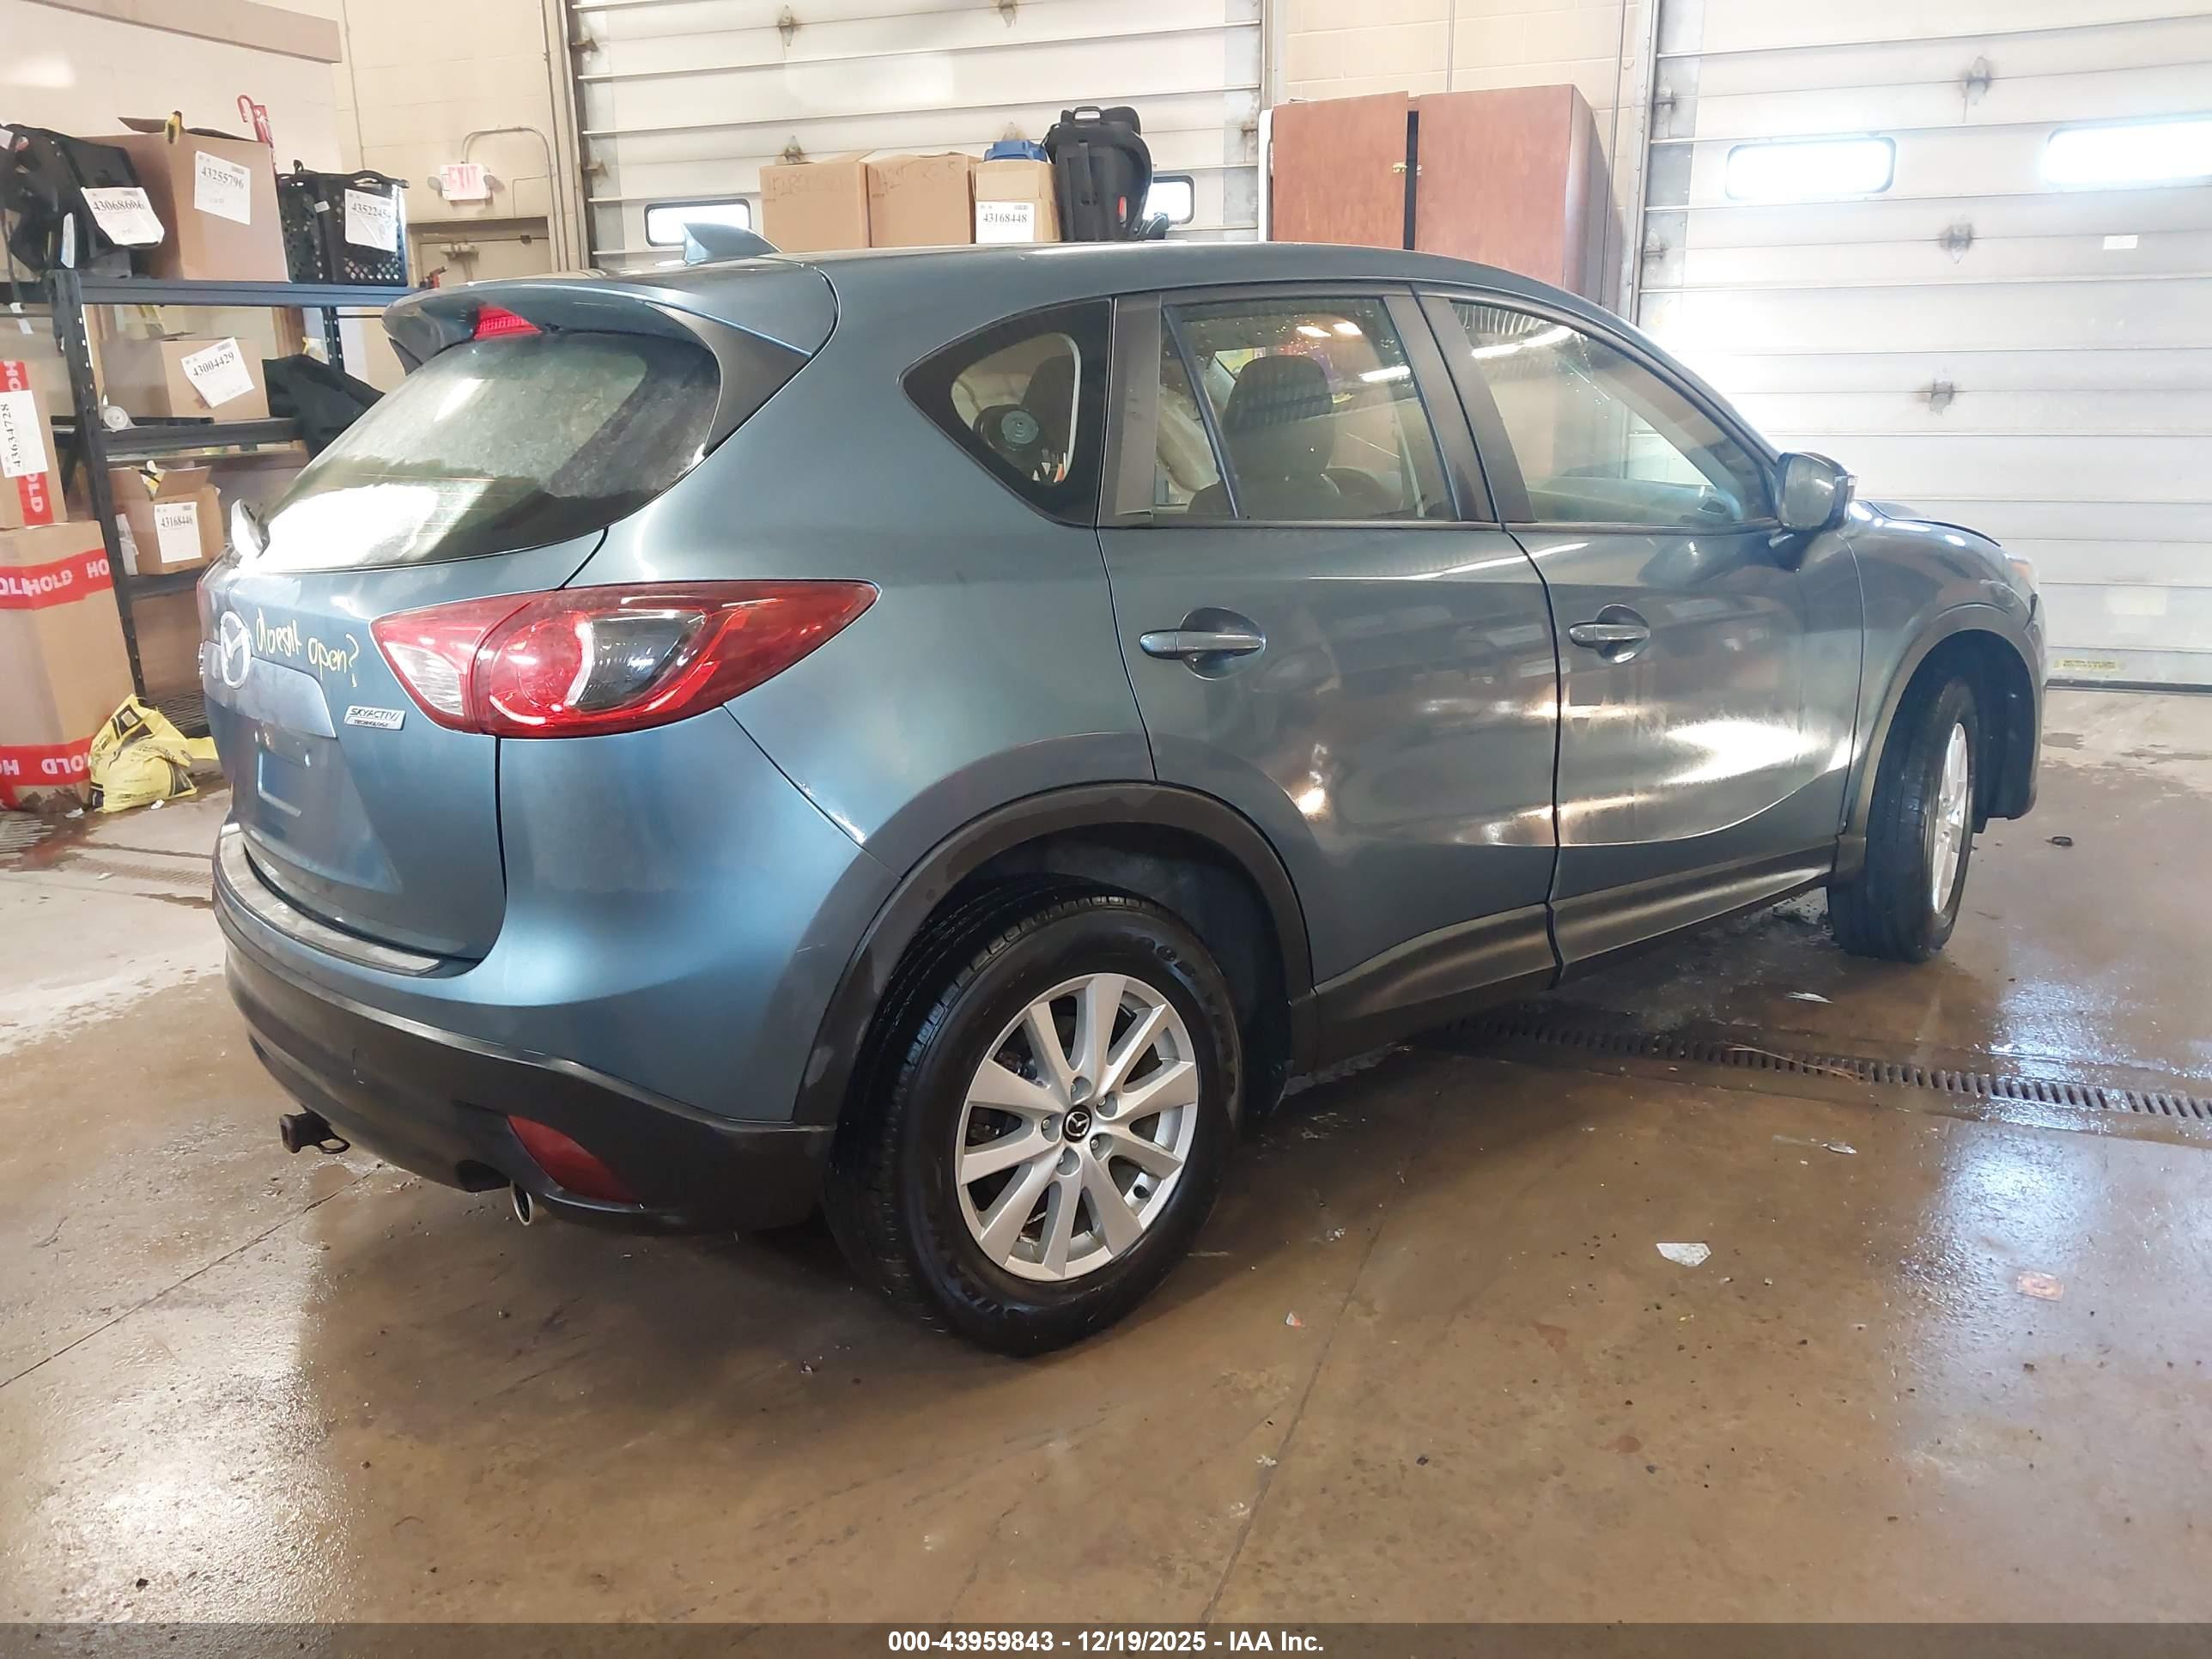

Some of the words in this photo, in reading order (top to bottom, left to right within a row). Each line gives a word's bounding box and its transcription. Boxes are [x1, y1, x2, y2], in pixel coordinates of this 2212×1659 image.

[201, 167, 244, 189] 43255796
[983, 213, 1027, 223] 43168448
[193, 350, 234, 376] 43004429
[307, 633, 359, 687] open?
[349, 708, 398, 720] SKYACTIV
